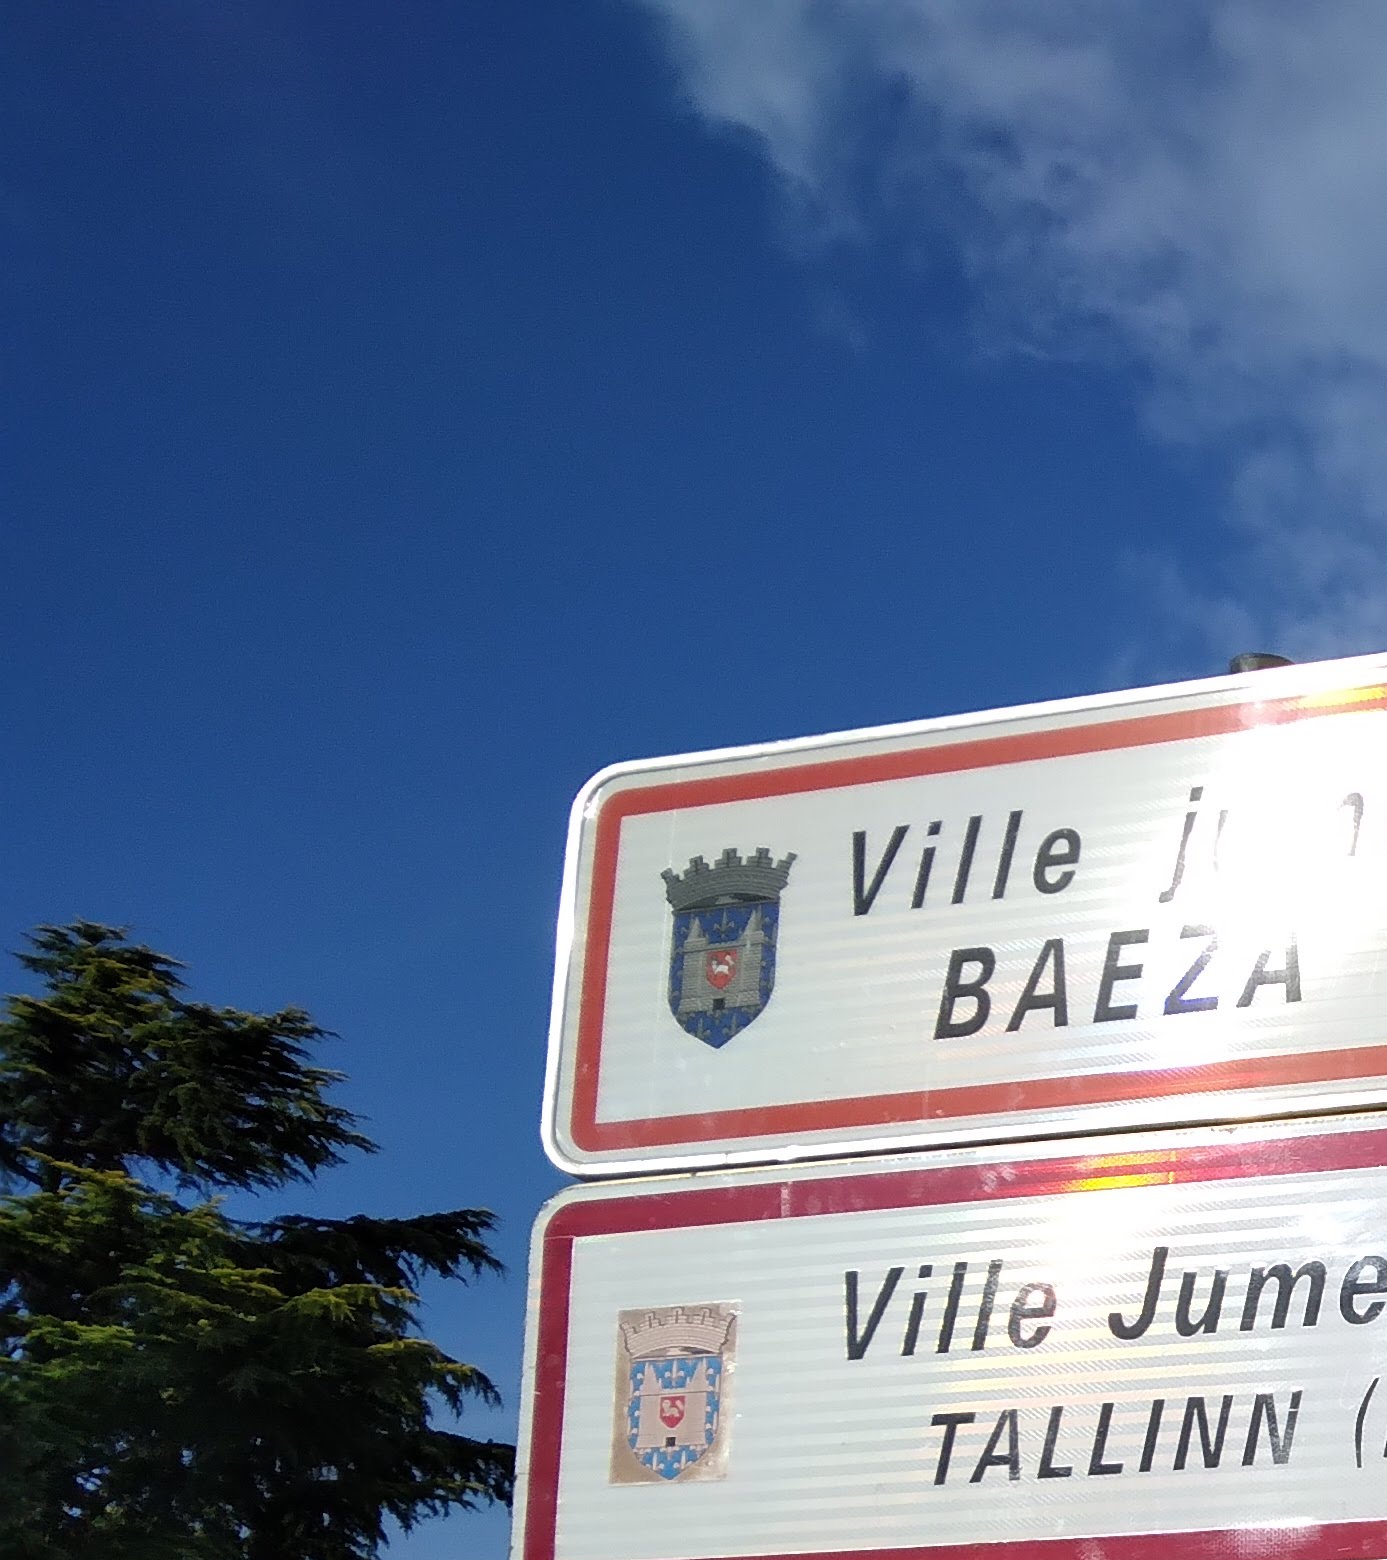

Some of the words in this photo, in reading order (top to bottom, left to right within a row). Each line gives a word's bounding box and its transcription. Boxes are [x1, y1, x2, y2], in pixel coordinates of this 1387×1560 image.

[851, 809, 1082, 916] Ville
[933, 925, 1303, 1041] BAEZA
[844, 1258, 1057, 1361] Ville
[930, 1390, 1302, 1486] TALLINN
